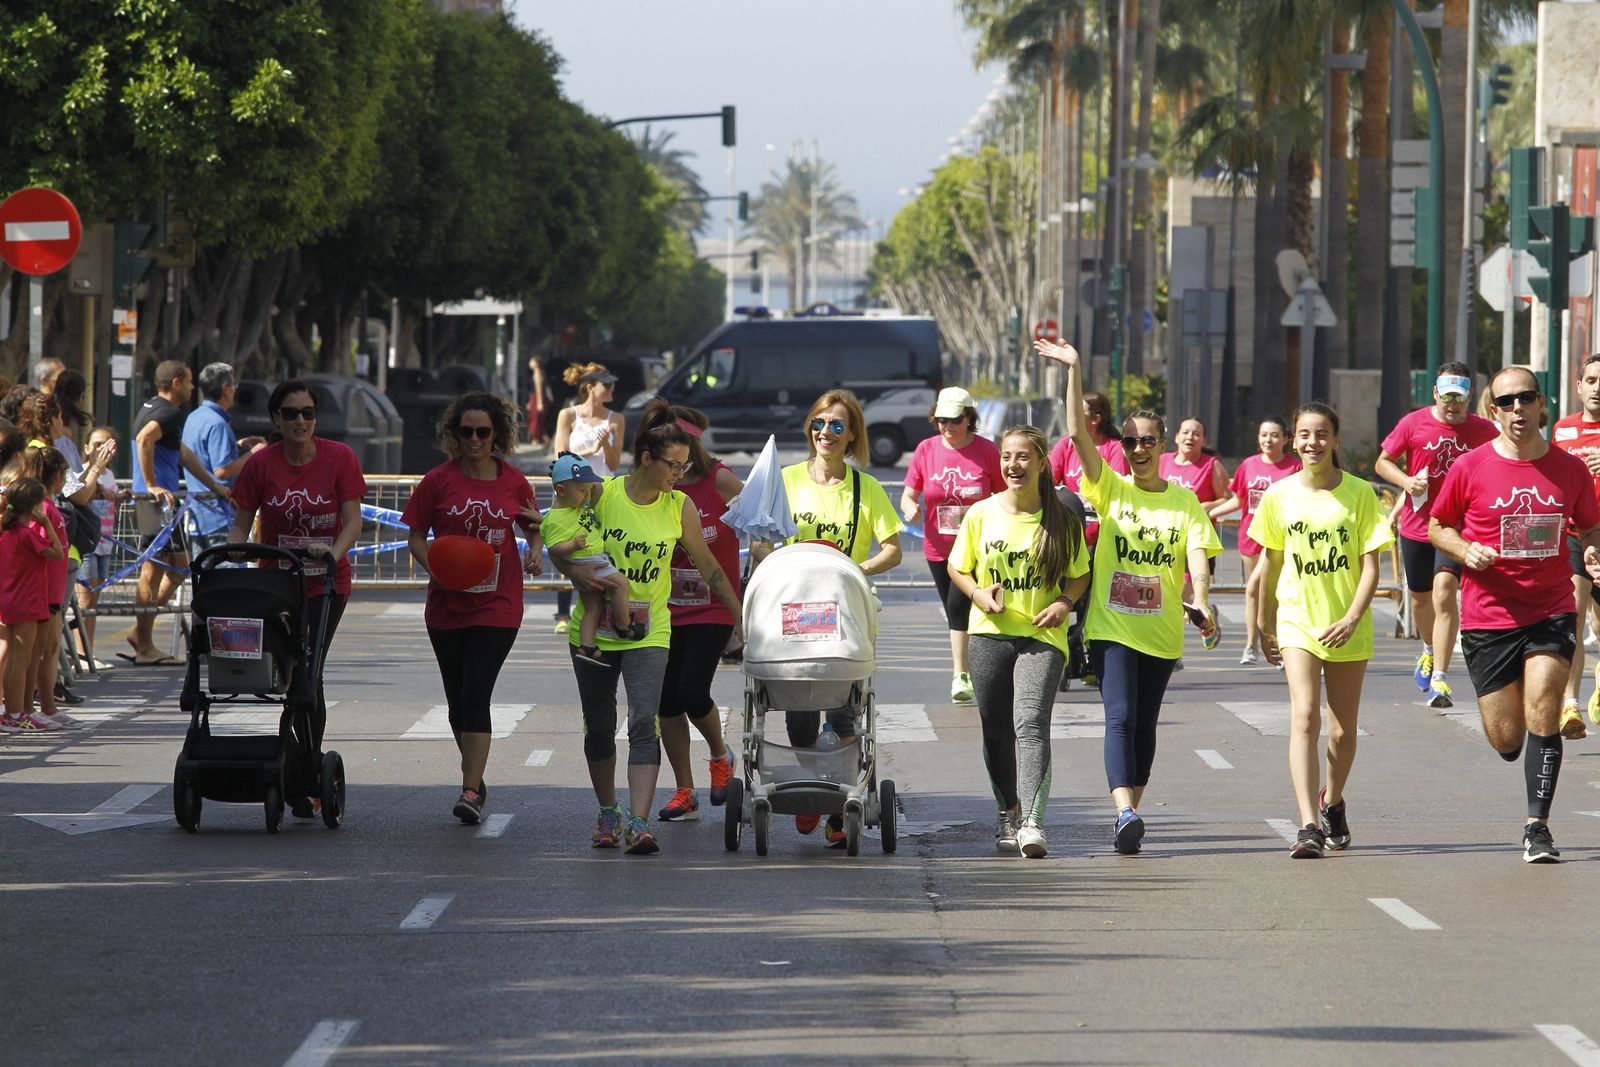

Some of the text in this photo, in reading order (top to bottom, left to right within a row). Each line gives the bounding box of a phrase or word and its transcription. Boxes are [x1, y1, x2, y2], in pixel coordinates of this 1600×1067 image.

[794, 511, 817, 524] va
[602, 528, 627, 542] va
[816, 522, 841, 539] por
[1138, 525, 1181, 545] por ti
[1308, 526, 1350, 550] por ti
[624, 540, 668, 560] por ti
[985, 540, 1008, 554] va
[1114, 535, 1176, 568] Paula
[1007, 549, 1032, 568] por
[1292, 546, 1351, 580] Paula
[682, 581, 698, 593] 47
[1137, 587, 1155, 601] 10
[799, 612, 838, 625] 2012
